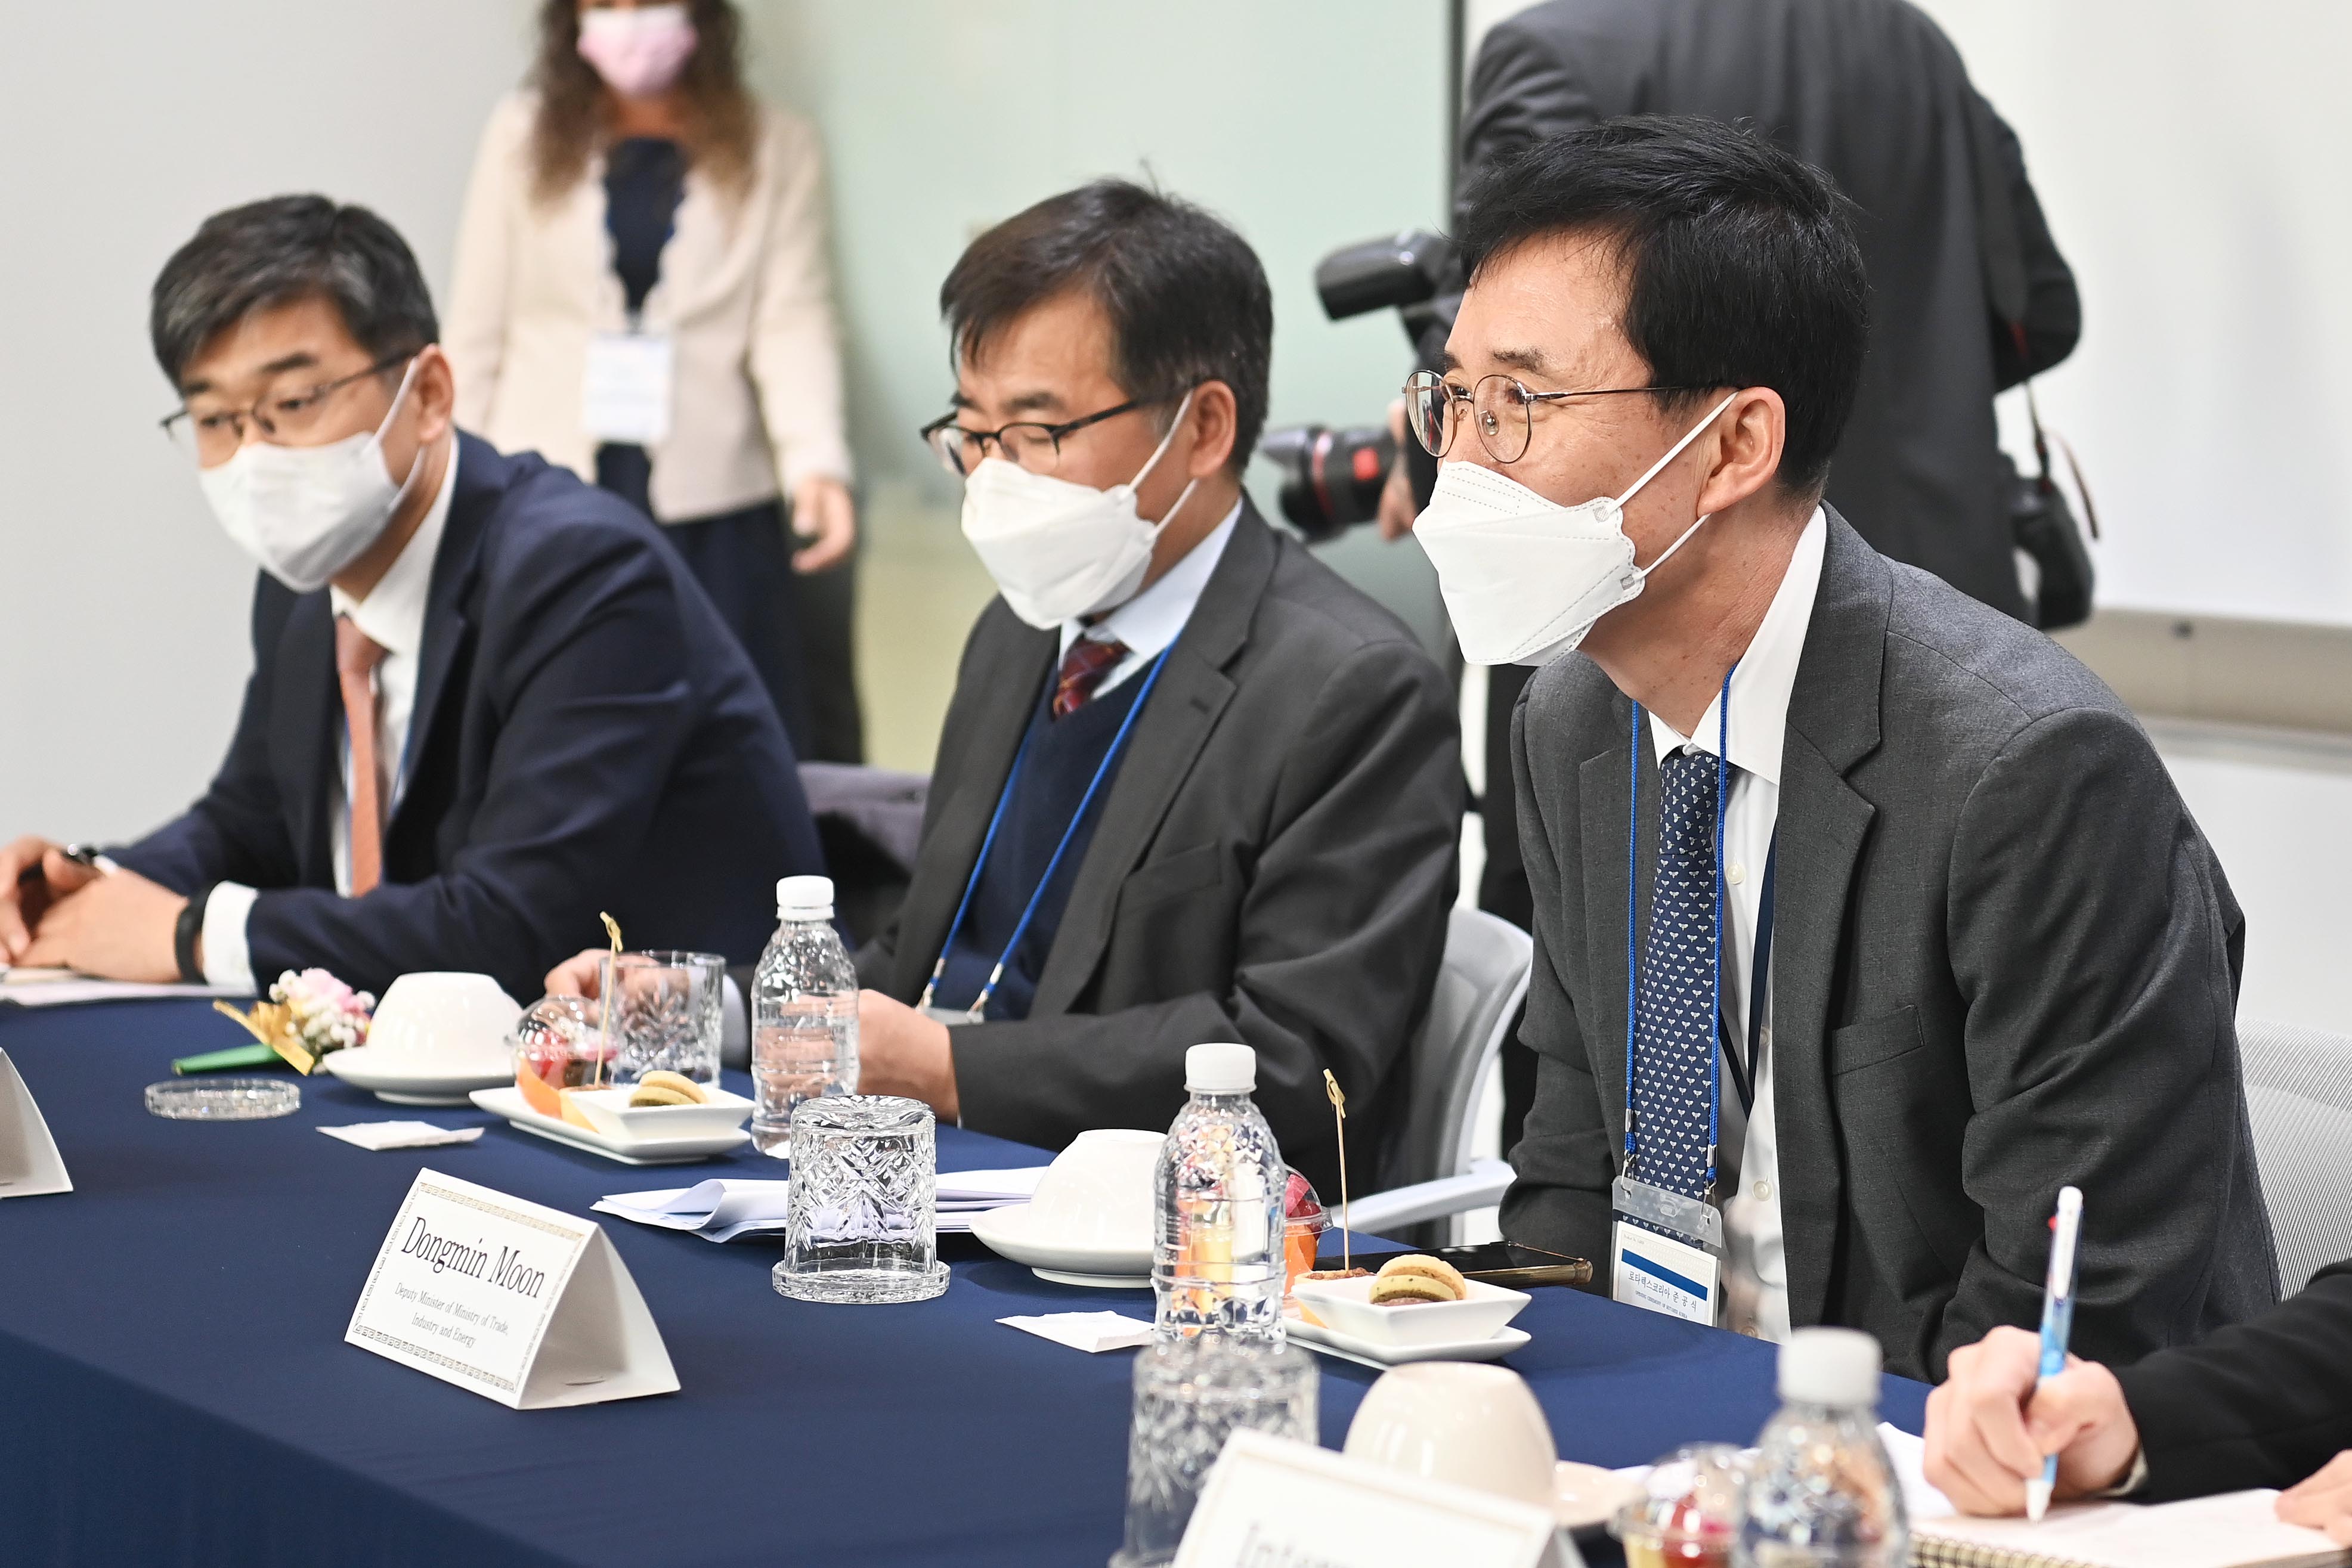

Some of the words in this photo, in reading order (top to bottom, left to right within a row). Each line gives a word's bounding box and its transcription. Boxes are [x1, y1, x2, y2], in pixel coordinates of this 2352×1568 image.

[401, 1217, 487, 1278] Dongmin
[487, 1246, 544, 1298] Moon
[395, 1282, 418, 1302] Deputy
[417, 1290, 445, 1310] Minister
[445, 1301, 455, 1313] of
[453, 1303, 480, 1325] Ministry
[481, 1314, 491, 1327] of
[411, 1312, 439, 1335] Industry
[439, 1325, 454, 1338] and
[452, 1327, 476, 1349] Energy
